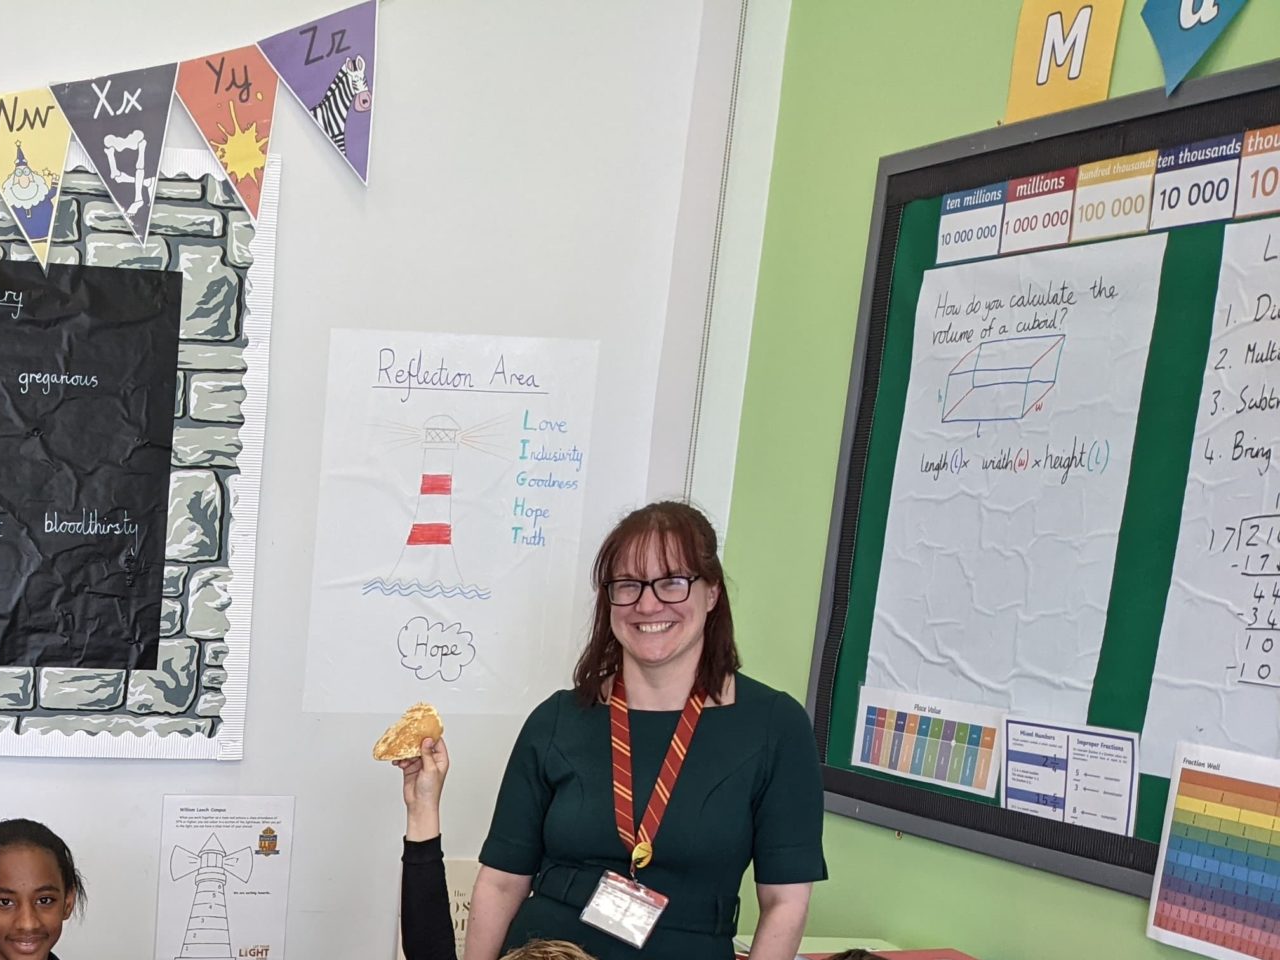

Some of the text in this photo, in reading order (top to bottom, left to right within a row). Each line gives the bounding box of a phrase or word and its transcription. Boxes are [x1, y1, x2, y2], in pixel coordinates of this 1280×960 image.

[299, 25, 351, 66] Zz
[1036, 5, 1093, 85] M
[205, 57, 253, 102] Yy
[91, 79, 143, 119] Xx
[1079, 158, 1155, 181] hundred thousands
[1157, 139, 1242, 169] ten thousands
[946, 188, 1002, 211] ten millions
[1015, 174, 1065, 198] millions
[1159, 178, 1230, 211] 10 000
[1078, 195, 1145, 223] 100 000
[934, 275, 1119, 321] How do you calculate the
[932, 307, 1069, 345] volume of a cuboid?
[18, 371, 99, 395] gregarious
[378, 348, 540, 402] Reflection Area
[523, 409, 568, 432] Love
[518, 439, 583, 472] Inclusivity
[1231, 430, 1272, 476] Bring
[516, 470, 578, 490] Goodness
[513, 497, 550, 528] Hope
[44, 507, 138, 556] bloodthirsty
[511, 526, 545, 547] Truth
[414, 633, 462, 668] Hope
